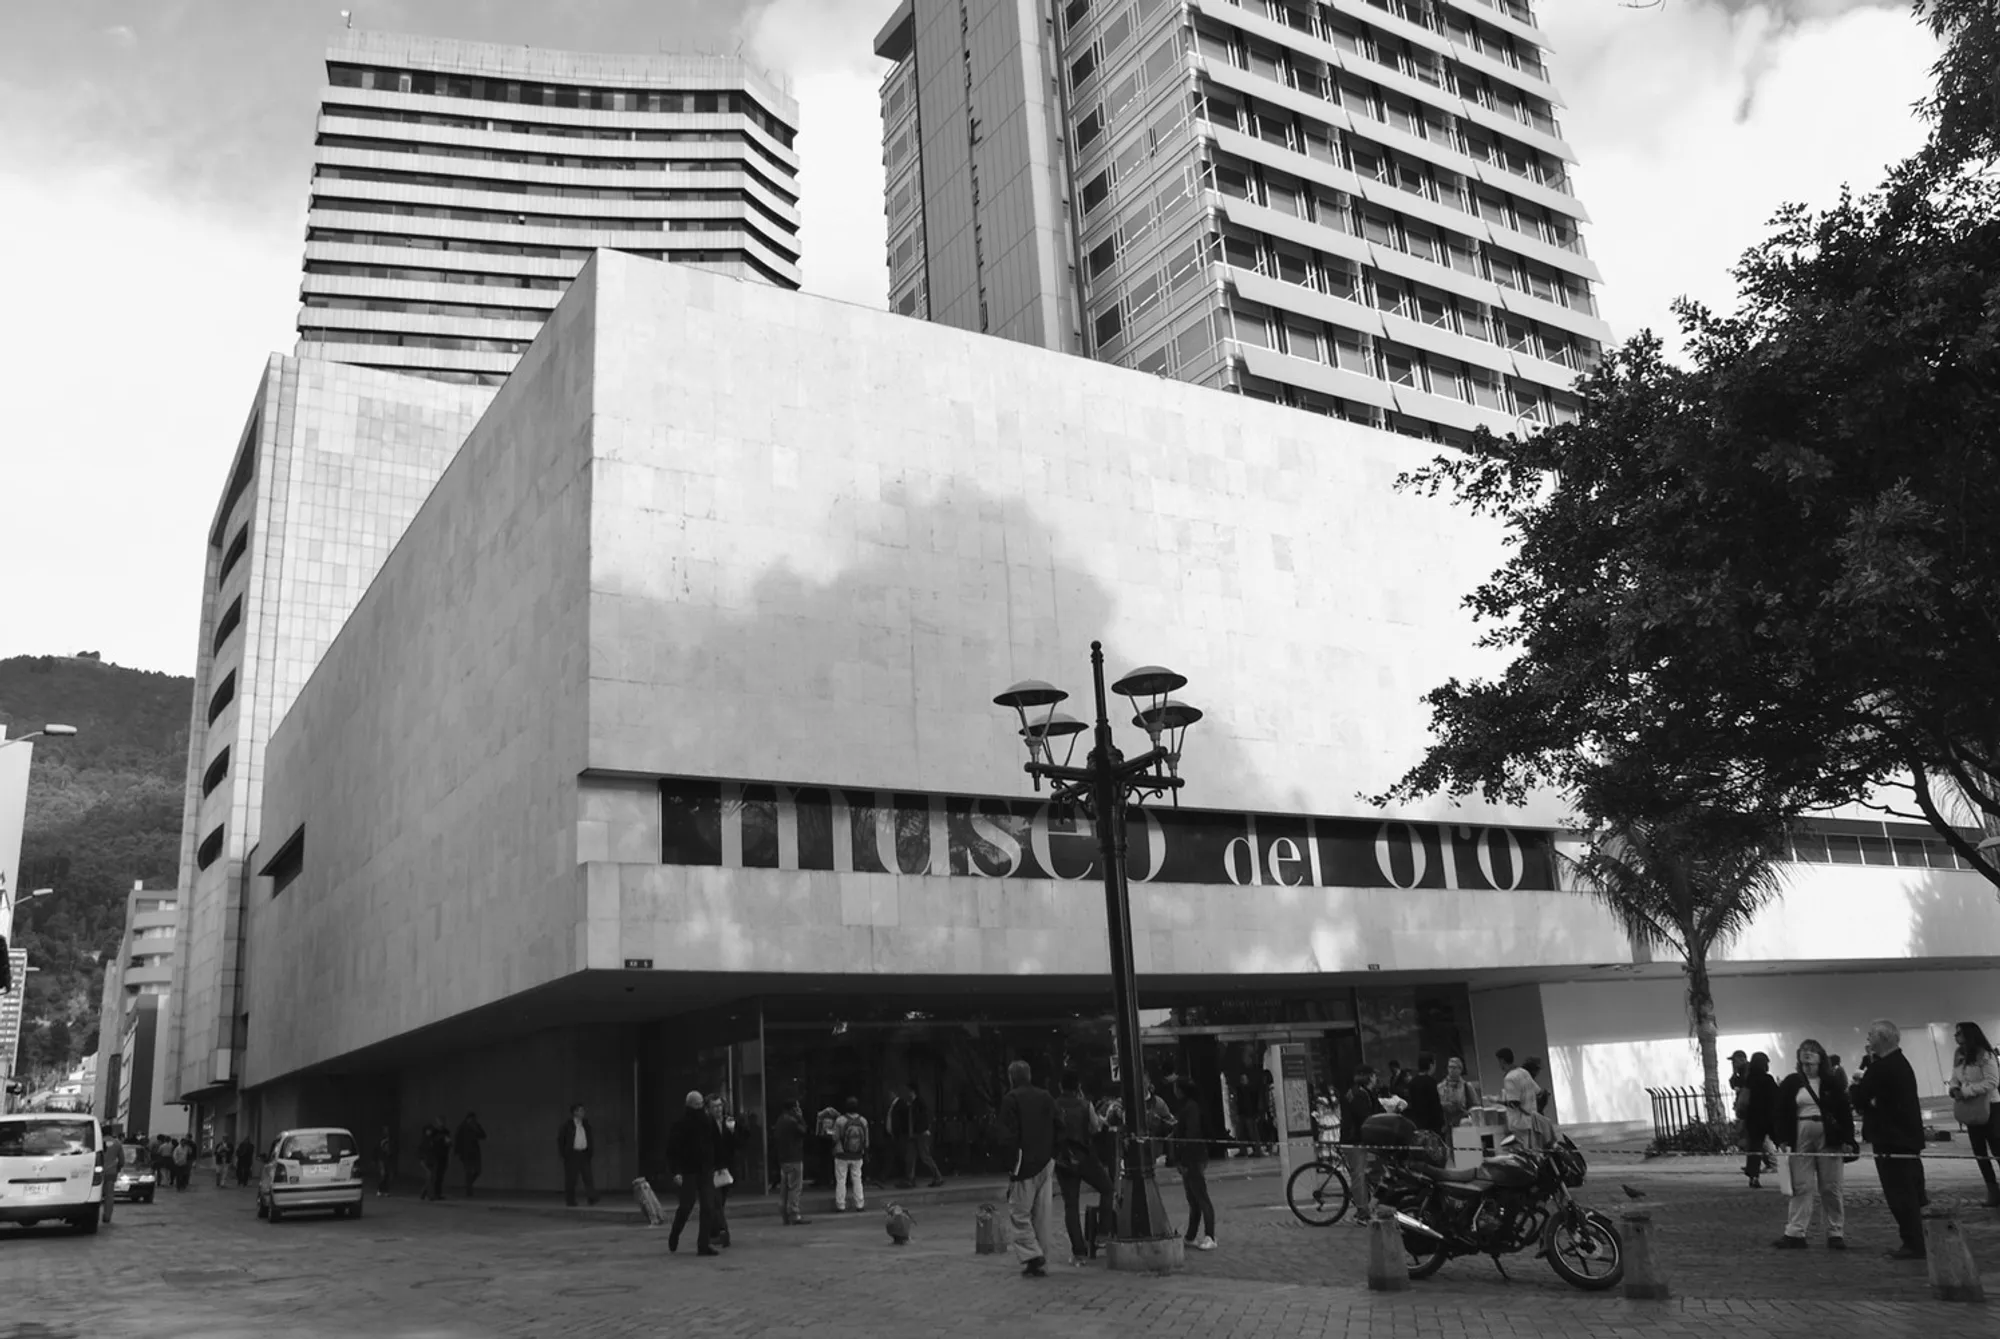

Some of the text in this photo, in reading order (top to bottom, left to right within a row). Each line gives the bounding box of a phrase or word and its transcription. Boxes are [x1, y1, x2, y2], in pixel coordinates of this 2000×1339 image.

[719, 783, 1525, 892] museo del oro
